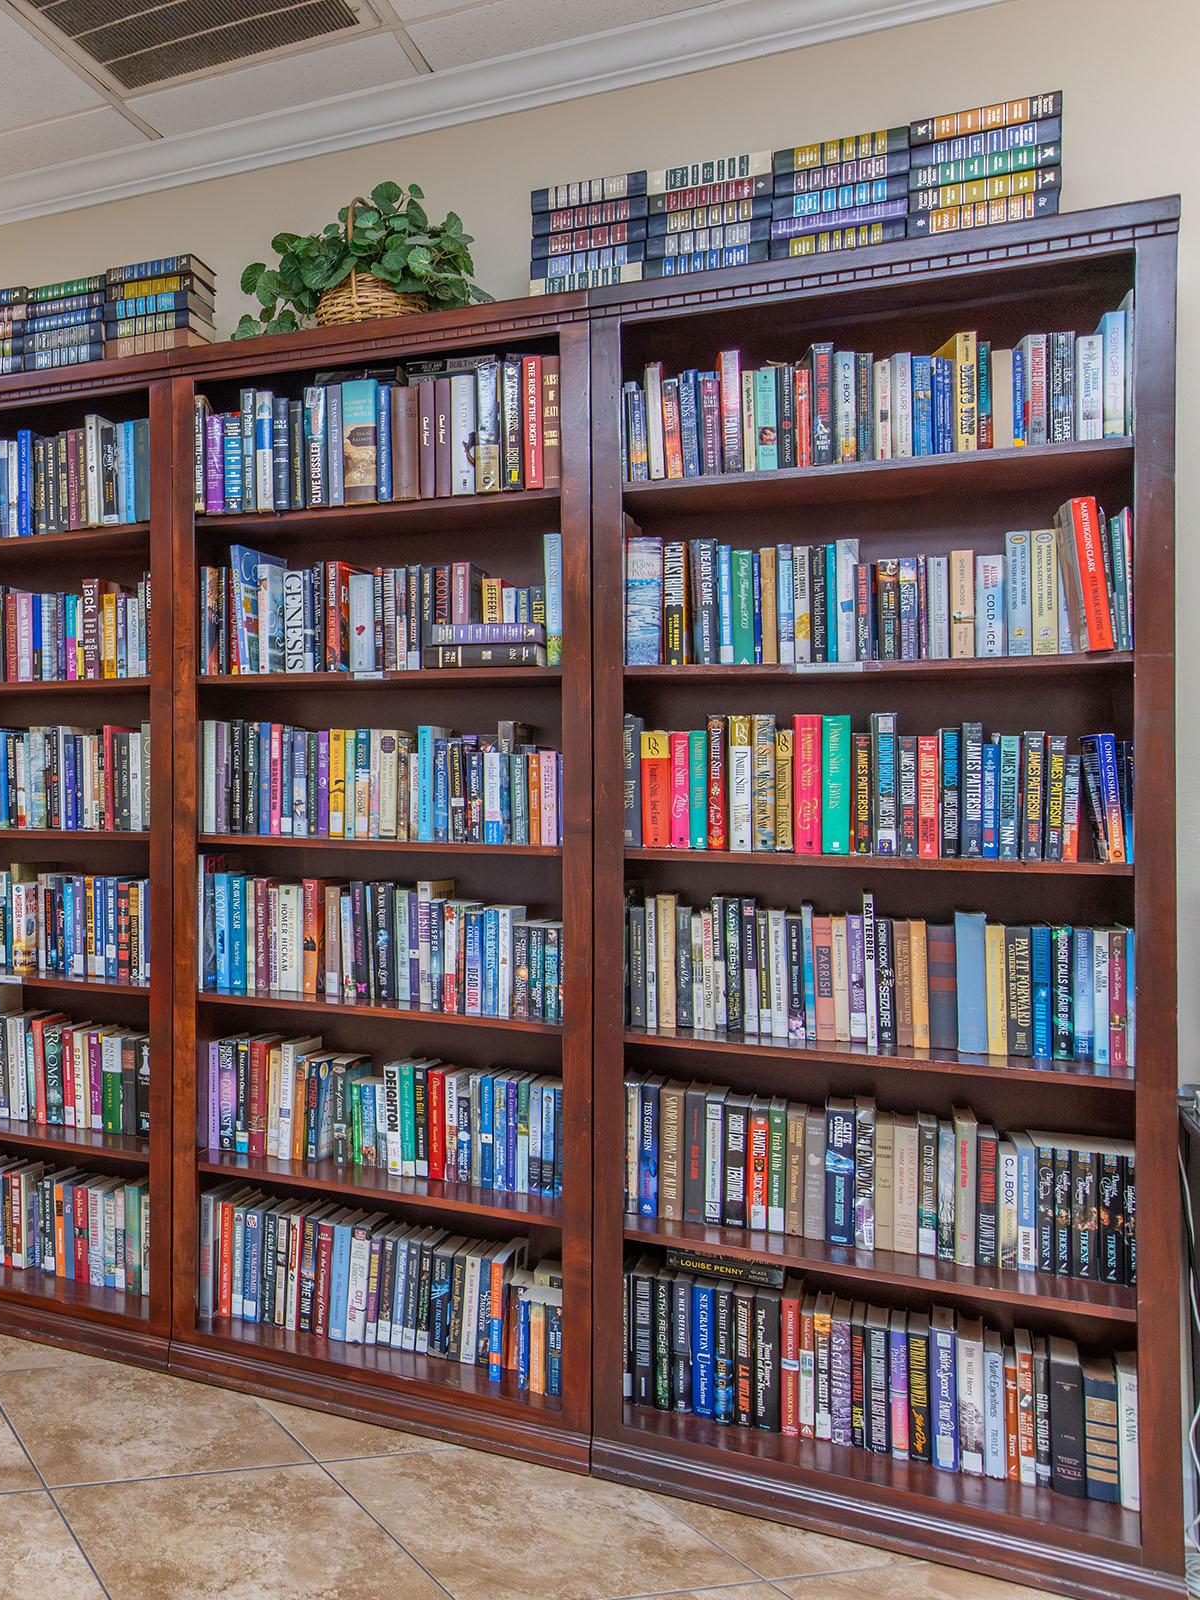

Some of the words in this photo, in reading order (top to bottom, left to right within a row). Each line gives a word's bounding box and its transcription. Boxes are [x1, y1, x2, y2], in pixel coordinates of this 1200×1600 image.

[528, 361, 536, 376] THE
[528, 378, 536, 395] RISE
[243, 393, 253, 414] Killing
[244, 415, 253, 435] Patton
[529, 424, 537, 446] RIGHT
[311, 443, 320, 478] CUSSLER
[312, 480, 321, 503] CLIVE
[1080, 502, 1089, 522] MARY
[1083, 522, 1093, 550] HIGGINS
[701, 551, 712, 581] DEADLY
[1086, 550, 1096, 572] CLARK
[664, 545, 684, 608] CATASTROPHE
[814, 577, 825, 591] The
[82, 585, 96, 613] jack
[436, 573, 448, 616] KOONTZ
[702, 583, 712, 605] GAME
[814, 593, 825, 615] World
[986, 594, 995, 620] COLD
[106, 606, 114, 625] JAMES
[285, 574, 303, 670] GENESIS
[815, 616, 822, 625] on
[106, 626, 114, 660] PATTERSON
[815, 626, 825, 648] Blood
[987, 631, 995, 645] ICE
[944, 732, 958, 759] LONDON
[966, 741, 981, 771] JAMES
[1104, 741, 1114, 763] JOHN
[435, 751, 445, 770] Prague
[944, 760, 958, 786] BRIDGES
[437, 771, 445, 807] Counterpoint
[966, 773, 981, 821] PATTERSON
[1106, 765, 1116, 802] GRISHAM
[728, 905, 736, 936] KATHY
[864, 903, 873, 921] RAT
[865, 924, 874, 960] TERRIER
[1015, 938, 1029, 958] PAY
[729, 941, 737, 976] REICHS
[820, 948, 830, 996] PARRISH
[1017, 960, 1029, 971] IT
[468, 968, 478, 1007] DEADLOCK
[1017, 974, 1030, 1027] FORWARD
[880, 985, 891, 1027] SEIZURE
[47, 1035, 59, 1086] ROOMS
[309, 1078, 317, 1107] OTHER
[386, 1070, 399, 1132] DEIGHTON
[448, 1113, 454, 1123] MY
[753, 1130, 766, 1157] HAVOC
[857, 1120, 873, 1147] JANET
[857, 1150, 873, 1199] EVANOVICH
[980, 1214, 994, 1238] BLOW
[980, 1240, 995, 1257] FLY
[1107, 1234, 1116, 1268] THOENE
[680, 1259, 711, 1271] LOUISE
[713, 1263, 744, 1276] PENNY
